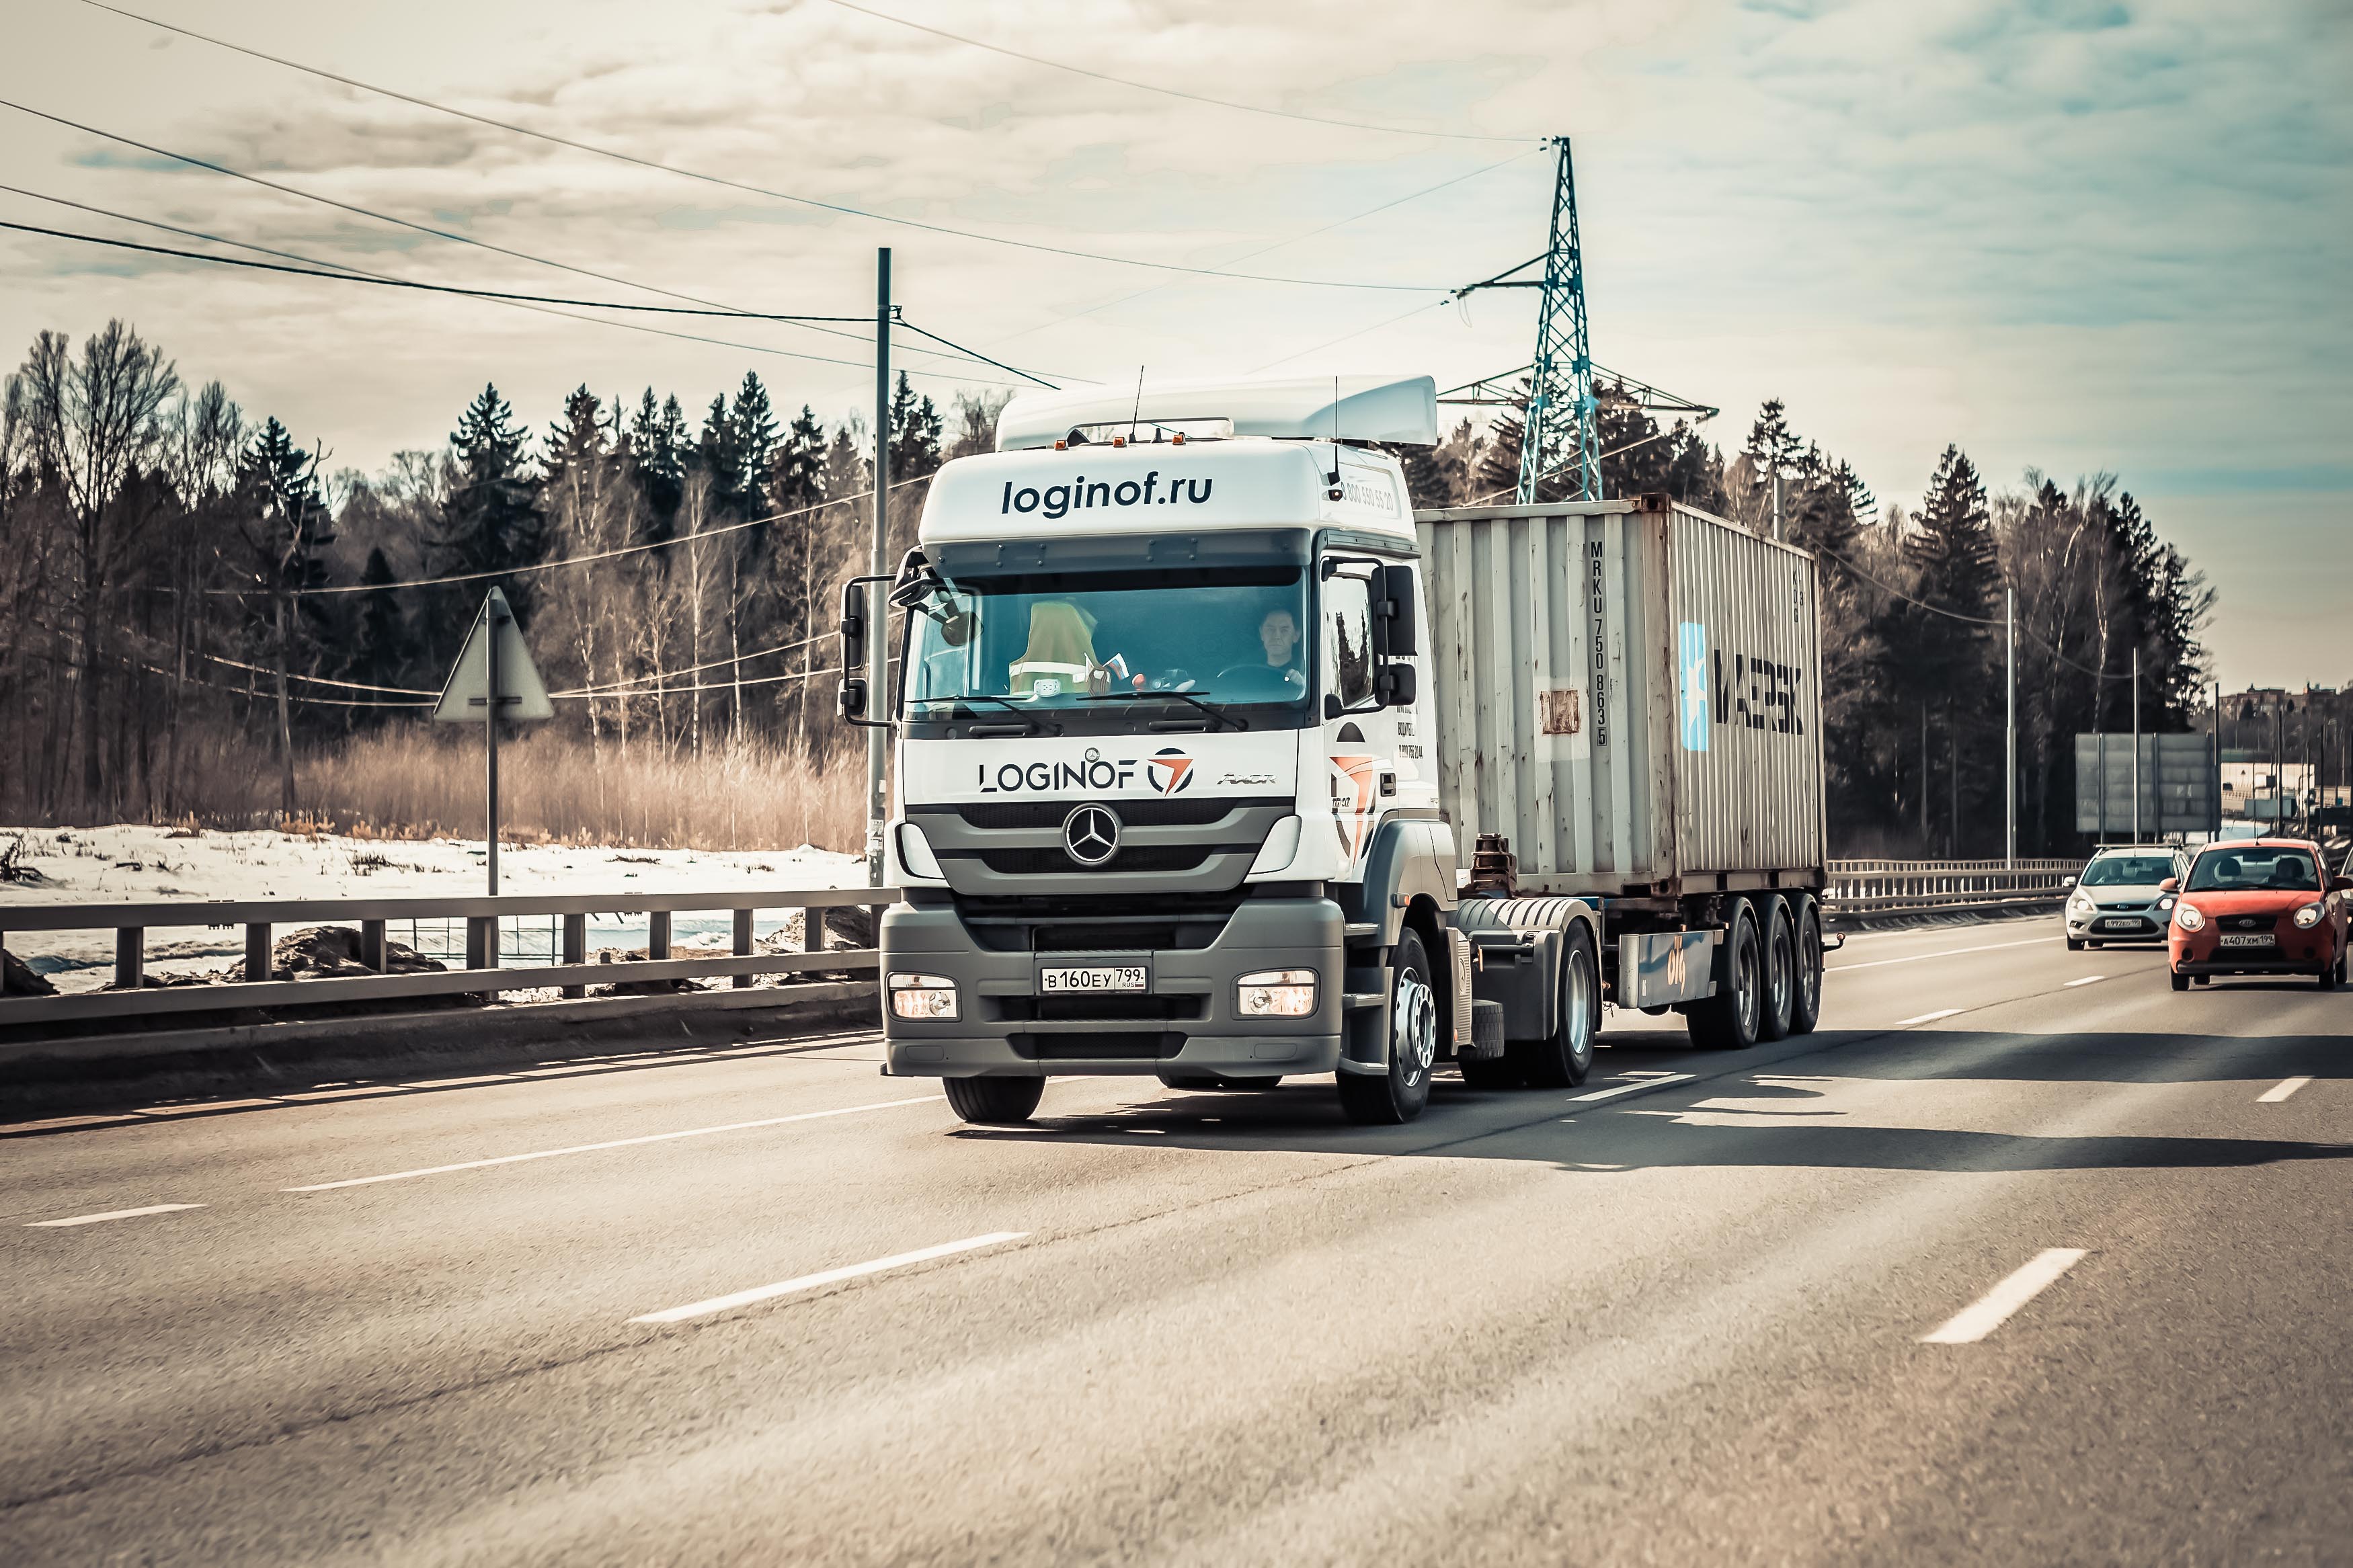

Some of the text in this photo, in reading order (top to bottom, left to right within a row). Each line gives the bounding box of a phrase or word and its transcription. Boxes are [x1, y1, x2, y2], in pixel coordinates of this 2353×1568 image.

[1002, 471, 1213, 519] loginof.ru
[1347, 483, 1361, 504] 800
[1361, 486, 1375, 507] 550
[1375, 489, 1384, 509] 55
[1384, 492, 1393, 511] 20
[1591, 541, 1606, 745] MRKU 750 863 5
[980, 759, 1138, 793] LOGINOF
[1115, 968, 1141, 982] 799
